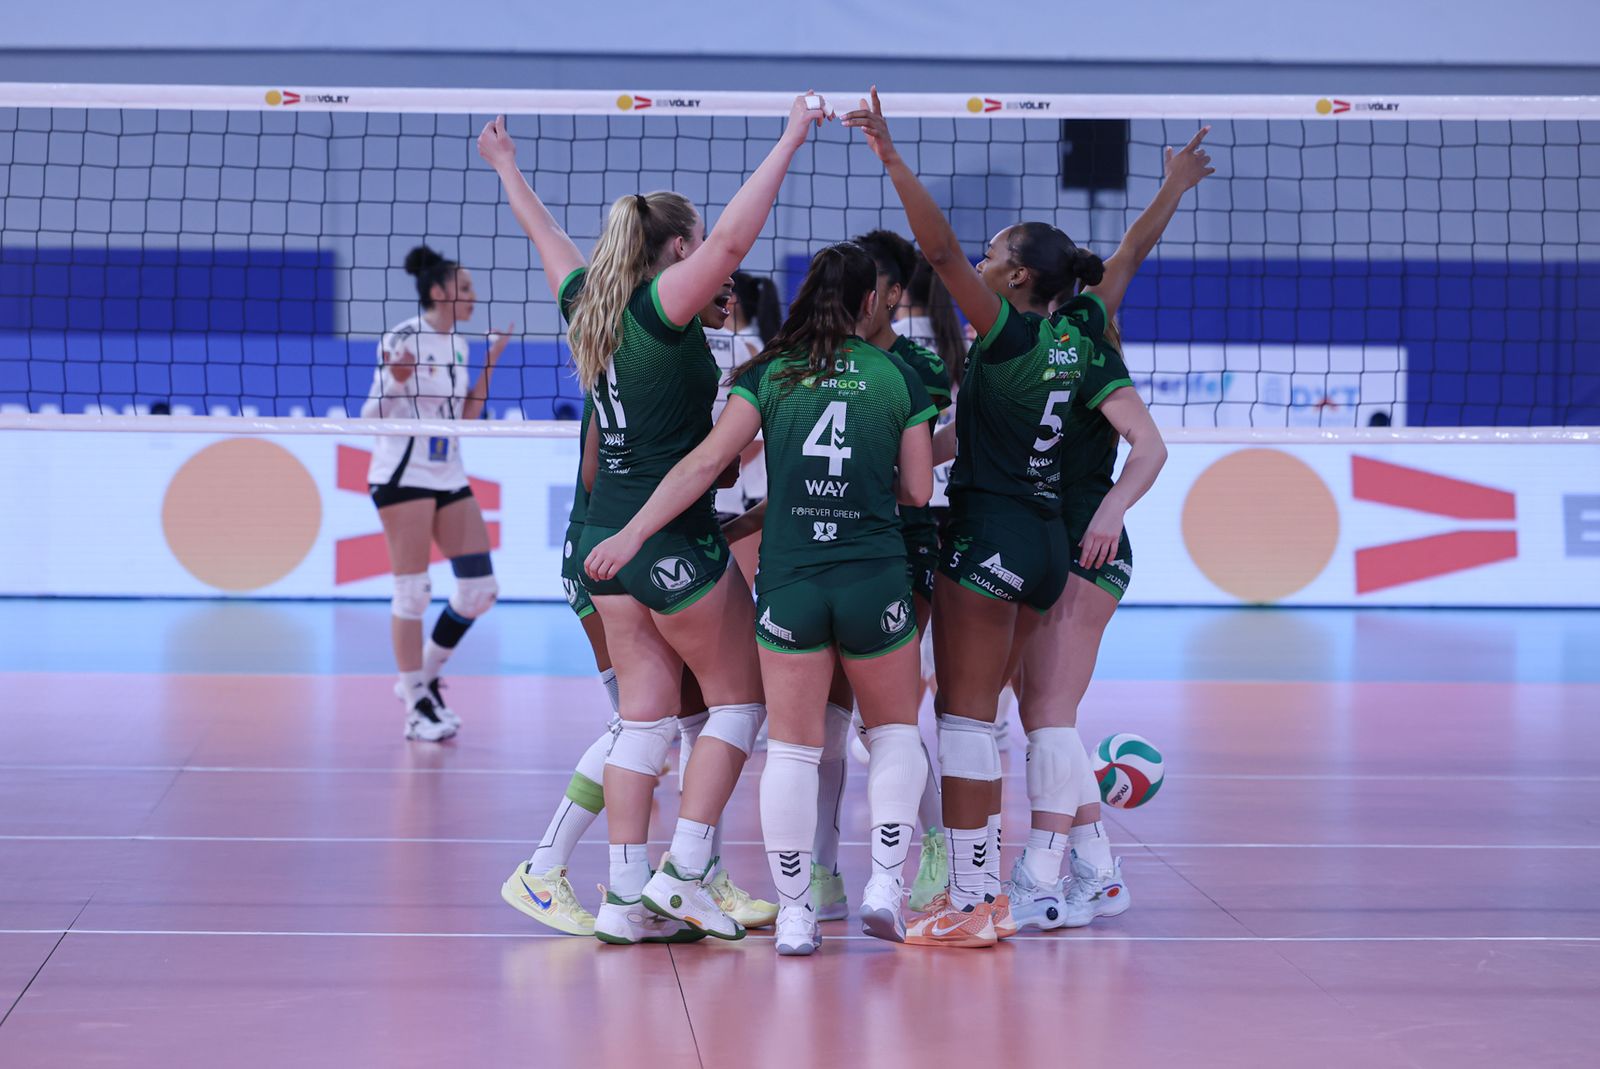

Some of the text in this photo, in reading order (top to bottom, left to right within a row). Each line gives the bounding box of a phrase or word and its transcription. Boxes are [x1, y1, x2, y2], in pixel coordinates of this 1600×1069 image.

[1048, 347, 1079, 365] BIRS
[821, 378, 867, 391] ERGOS
[1033, 390, 1071, 452] 5
[802, 401, 852, 477] 4
[805, 479, 849, 498] WAY
[791, 506, 861, 520] FOREVER GREEN
[949, 551, 962, 568] 5
